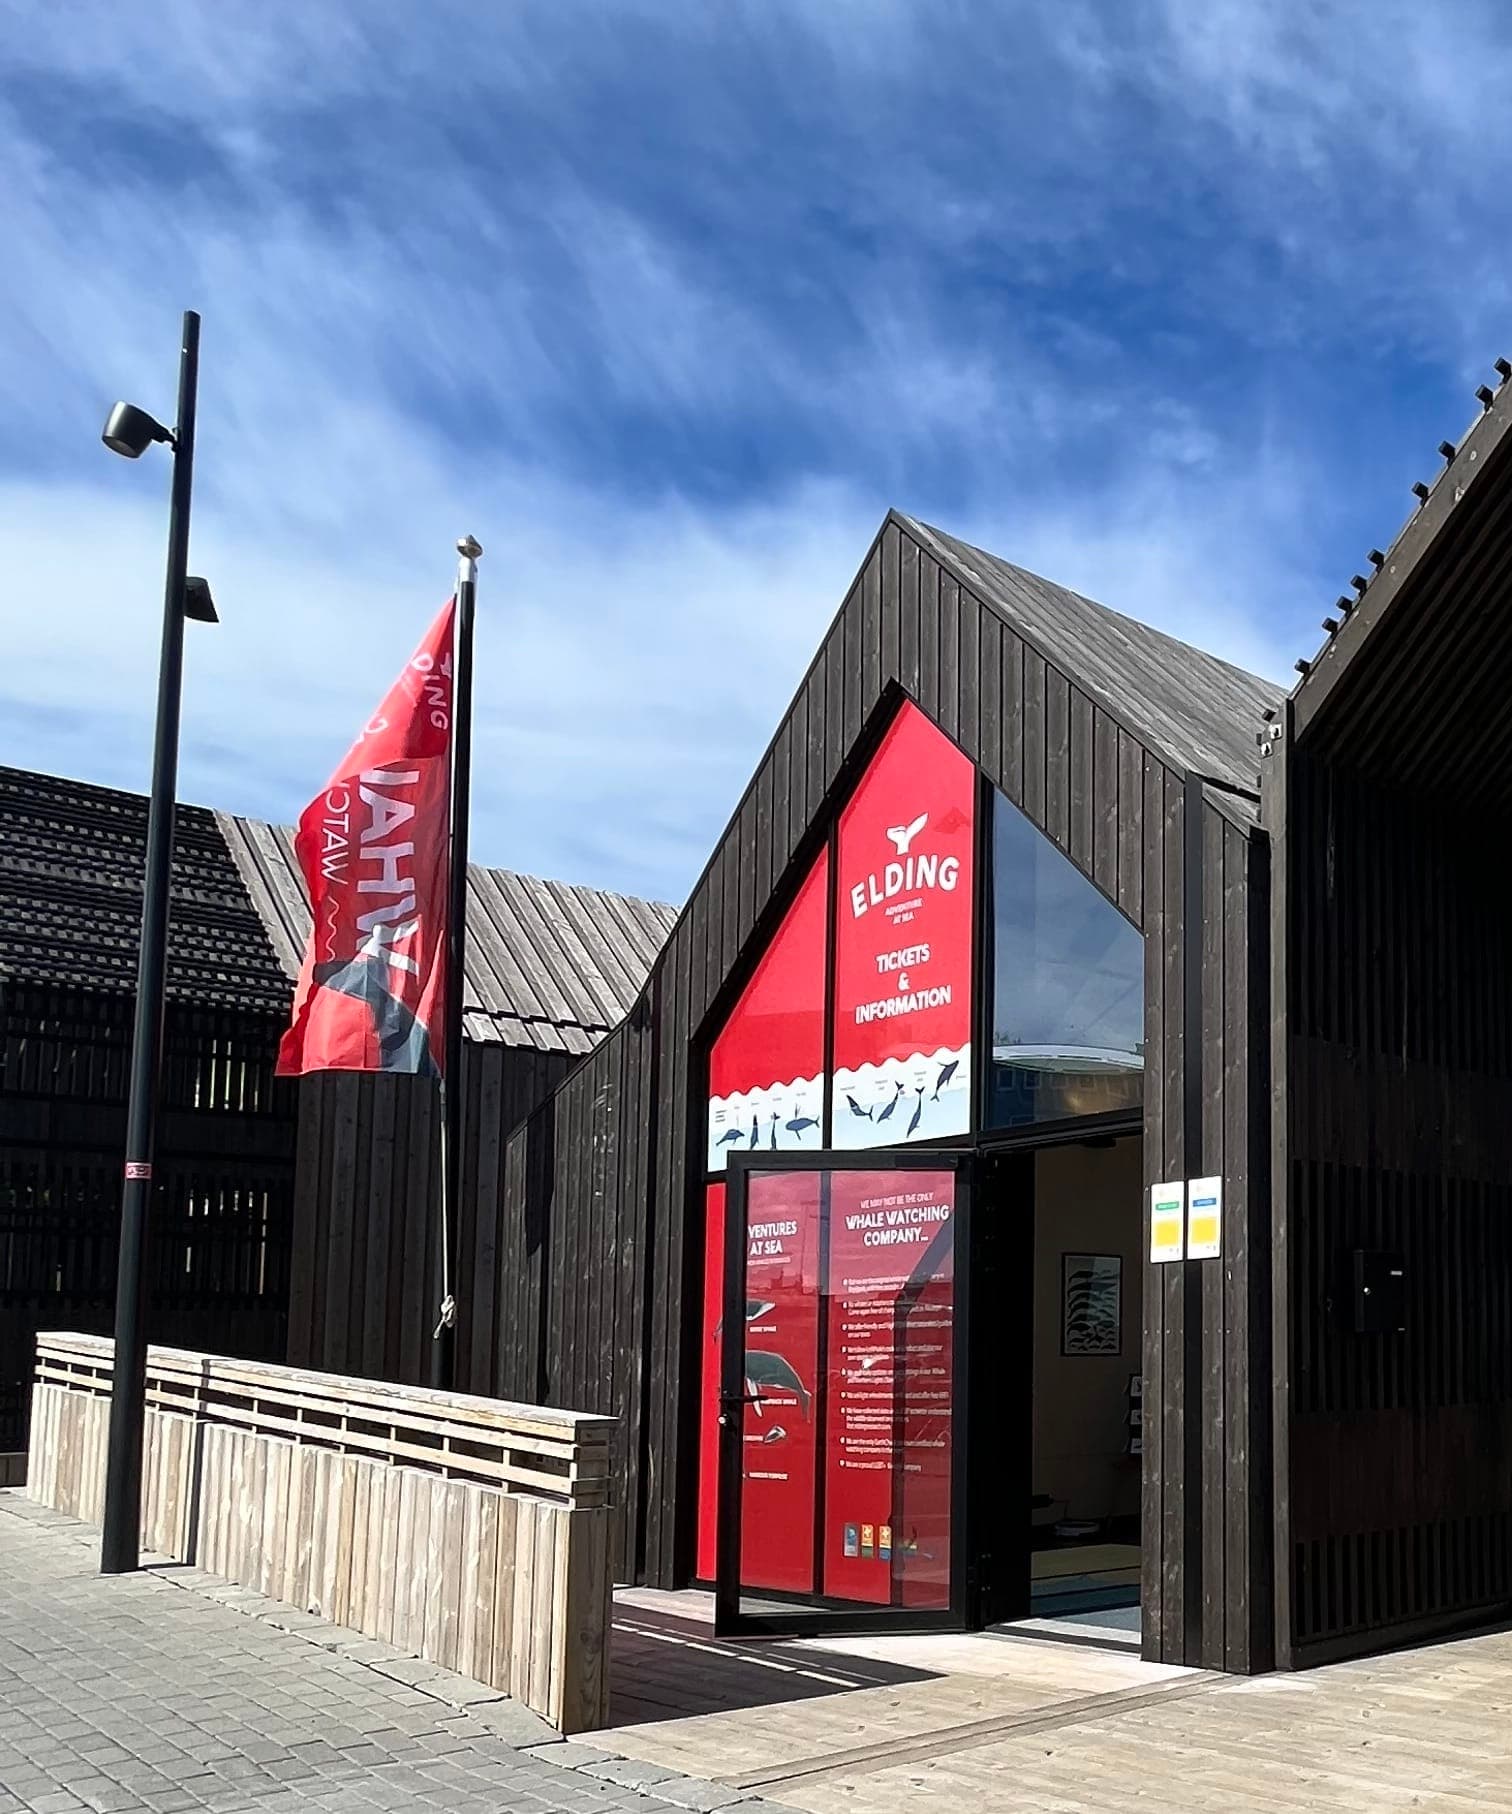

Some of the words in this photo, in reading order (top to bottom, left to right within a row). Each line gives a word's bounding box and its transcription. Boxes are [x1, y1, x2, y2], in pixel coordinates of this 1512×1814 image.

[851, 854, 960, 919] ELDING
[876, 943, 930, 973] TICKETS
[898, 972, 910, 991] &
[855, 985, 952, 1024] INFORMATION
[748, 1220, 798, 1239] VENTURES
[845, 1212, 885, 1230] WHALE
[886, 1204, 950, 1226] WATCHING
[750, 1241, 764, 1256] AT
[764, 1239, 783, 1255] SEA
